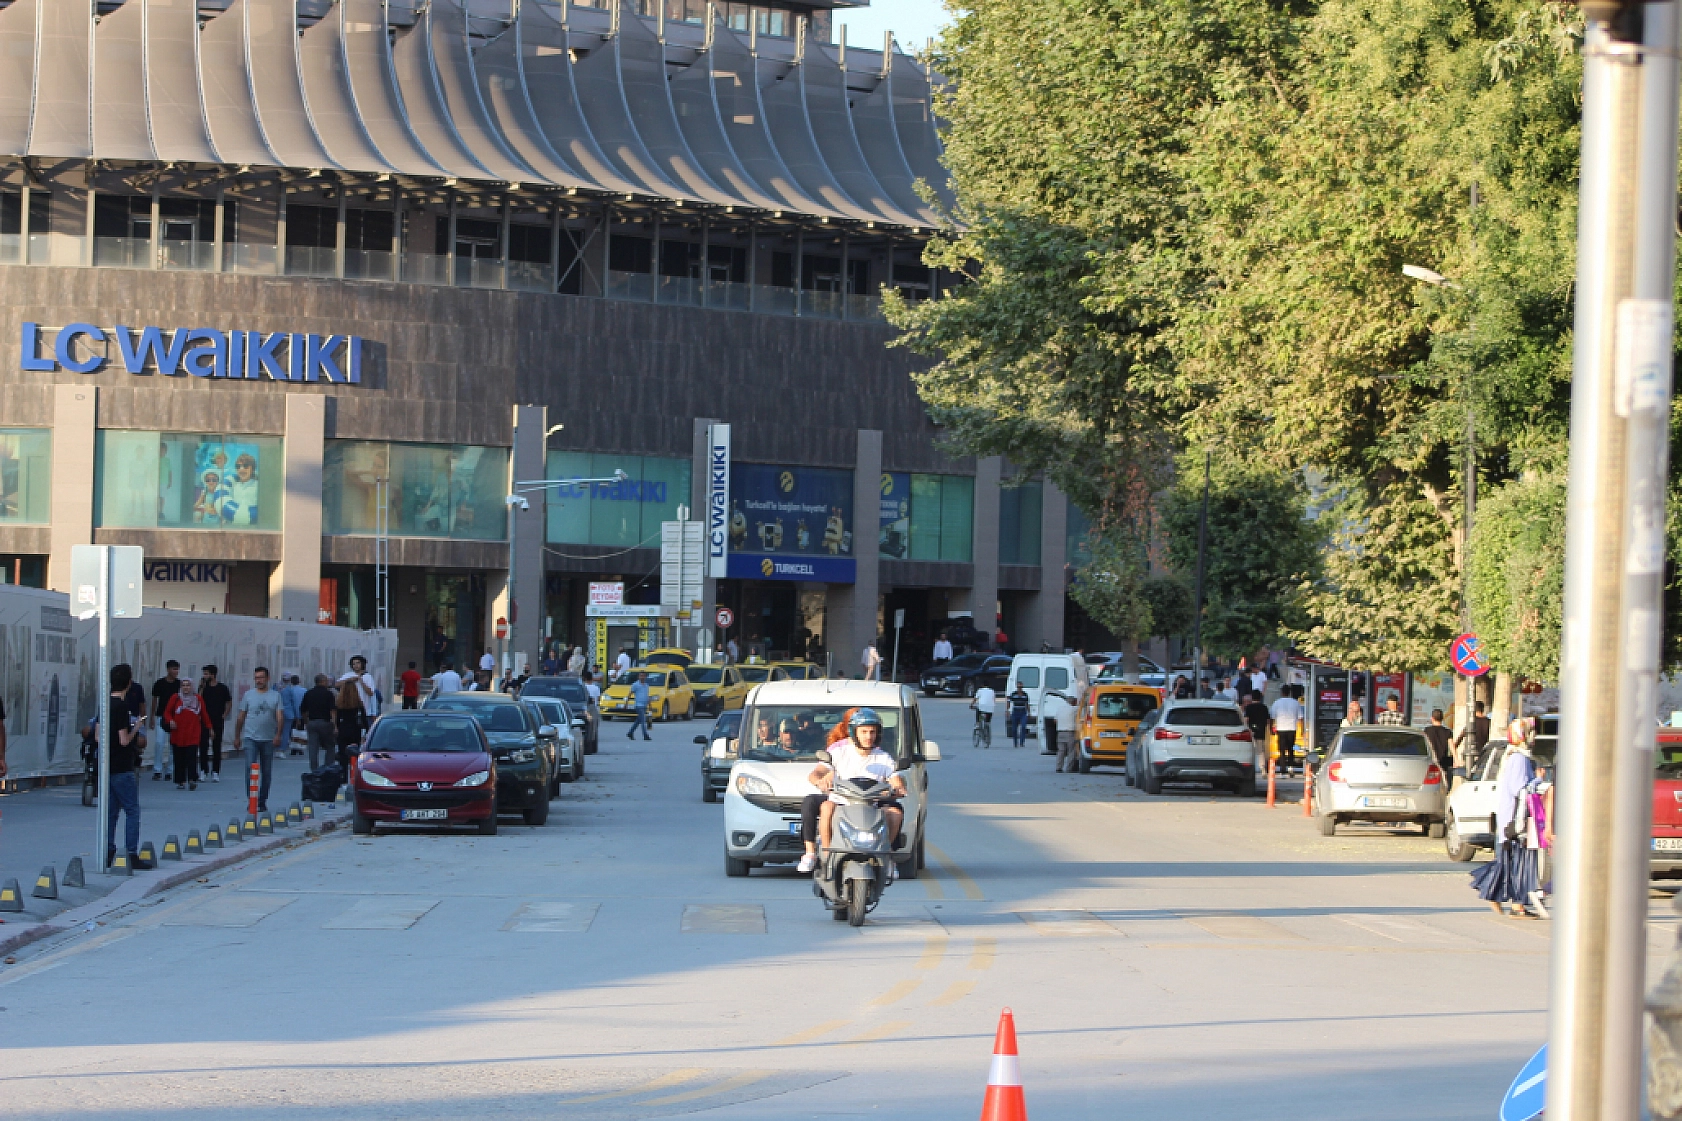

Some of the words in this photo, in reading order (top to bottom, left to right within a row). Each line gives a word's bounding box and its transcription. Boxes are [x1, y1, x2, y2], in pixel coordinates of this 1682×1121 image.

[20, 321, 107, 374] LC
[711, 530, 725, 557] LC
[774, 563, 815, 576] TURKCELL
[1656, 839, 1668, 849] 42
